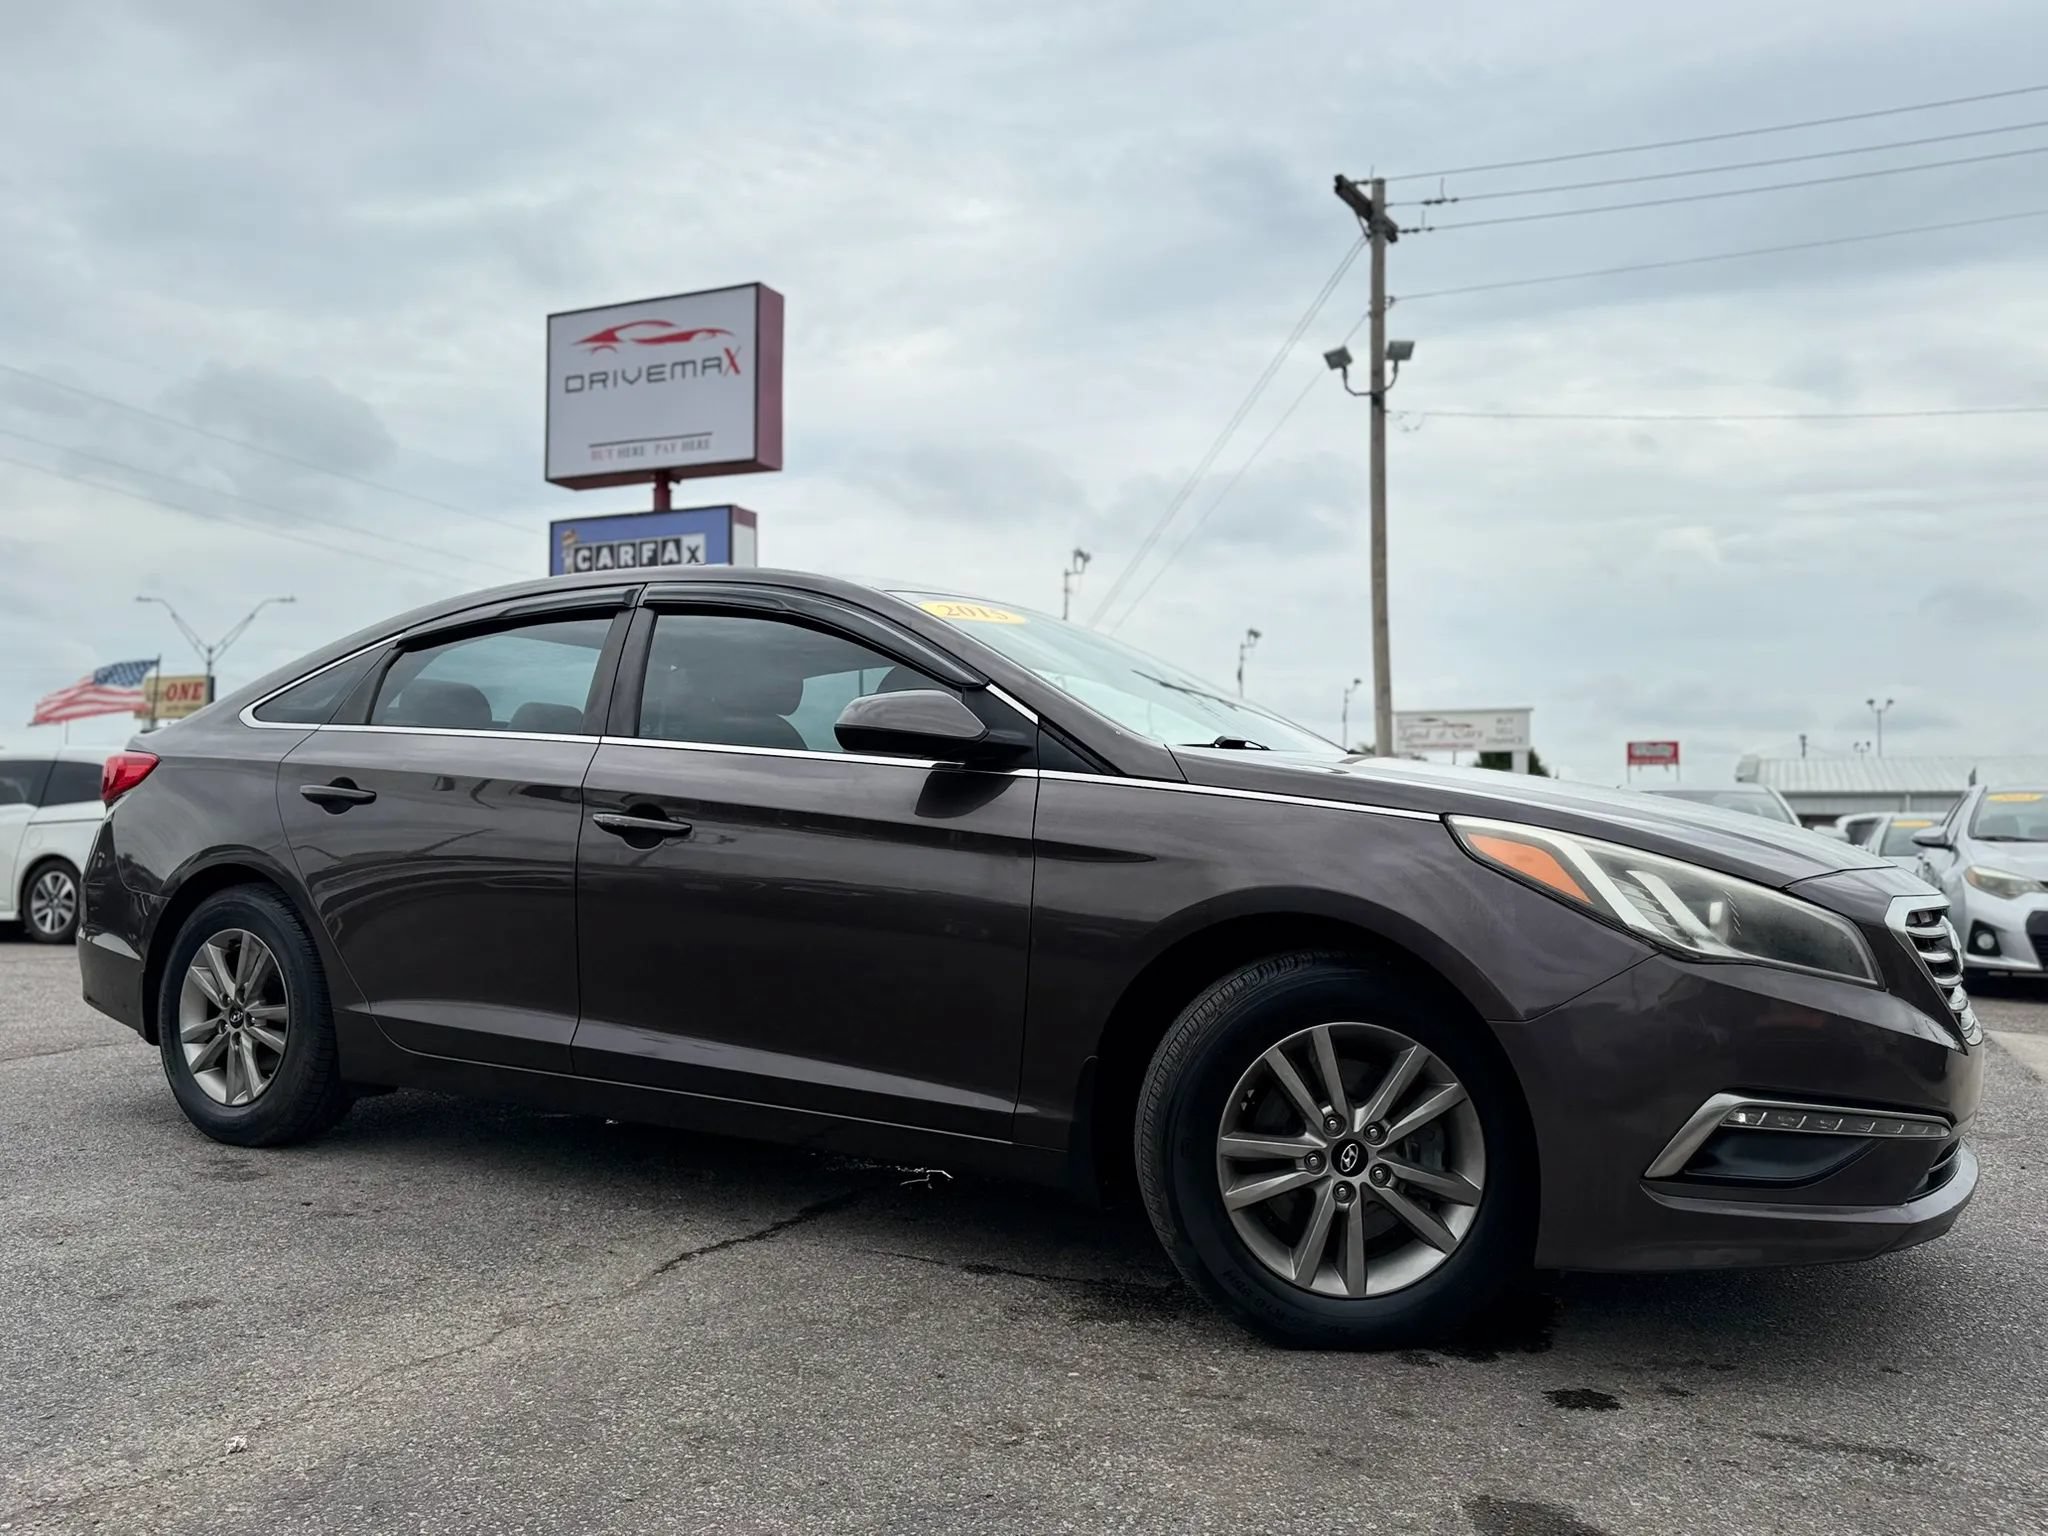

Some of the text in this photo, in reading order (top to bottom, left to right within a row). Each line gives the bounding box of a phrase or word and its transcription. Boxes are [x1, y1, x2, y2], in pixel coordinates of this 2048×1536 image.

[564, 346, 741, 393] DRIVEMAX
[590, 438, 711, 461] BUY HERE PAY HERE
[575, 539, 701, 570] CARFAX
[937, 604, 1009, 620] 2015
[166, 682, 204, 702] ONE
